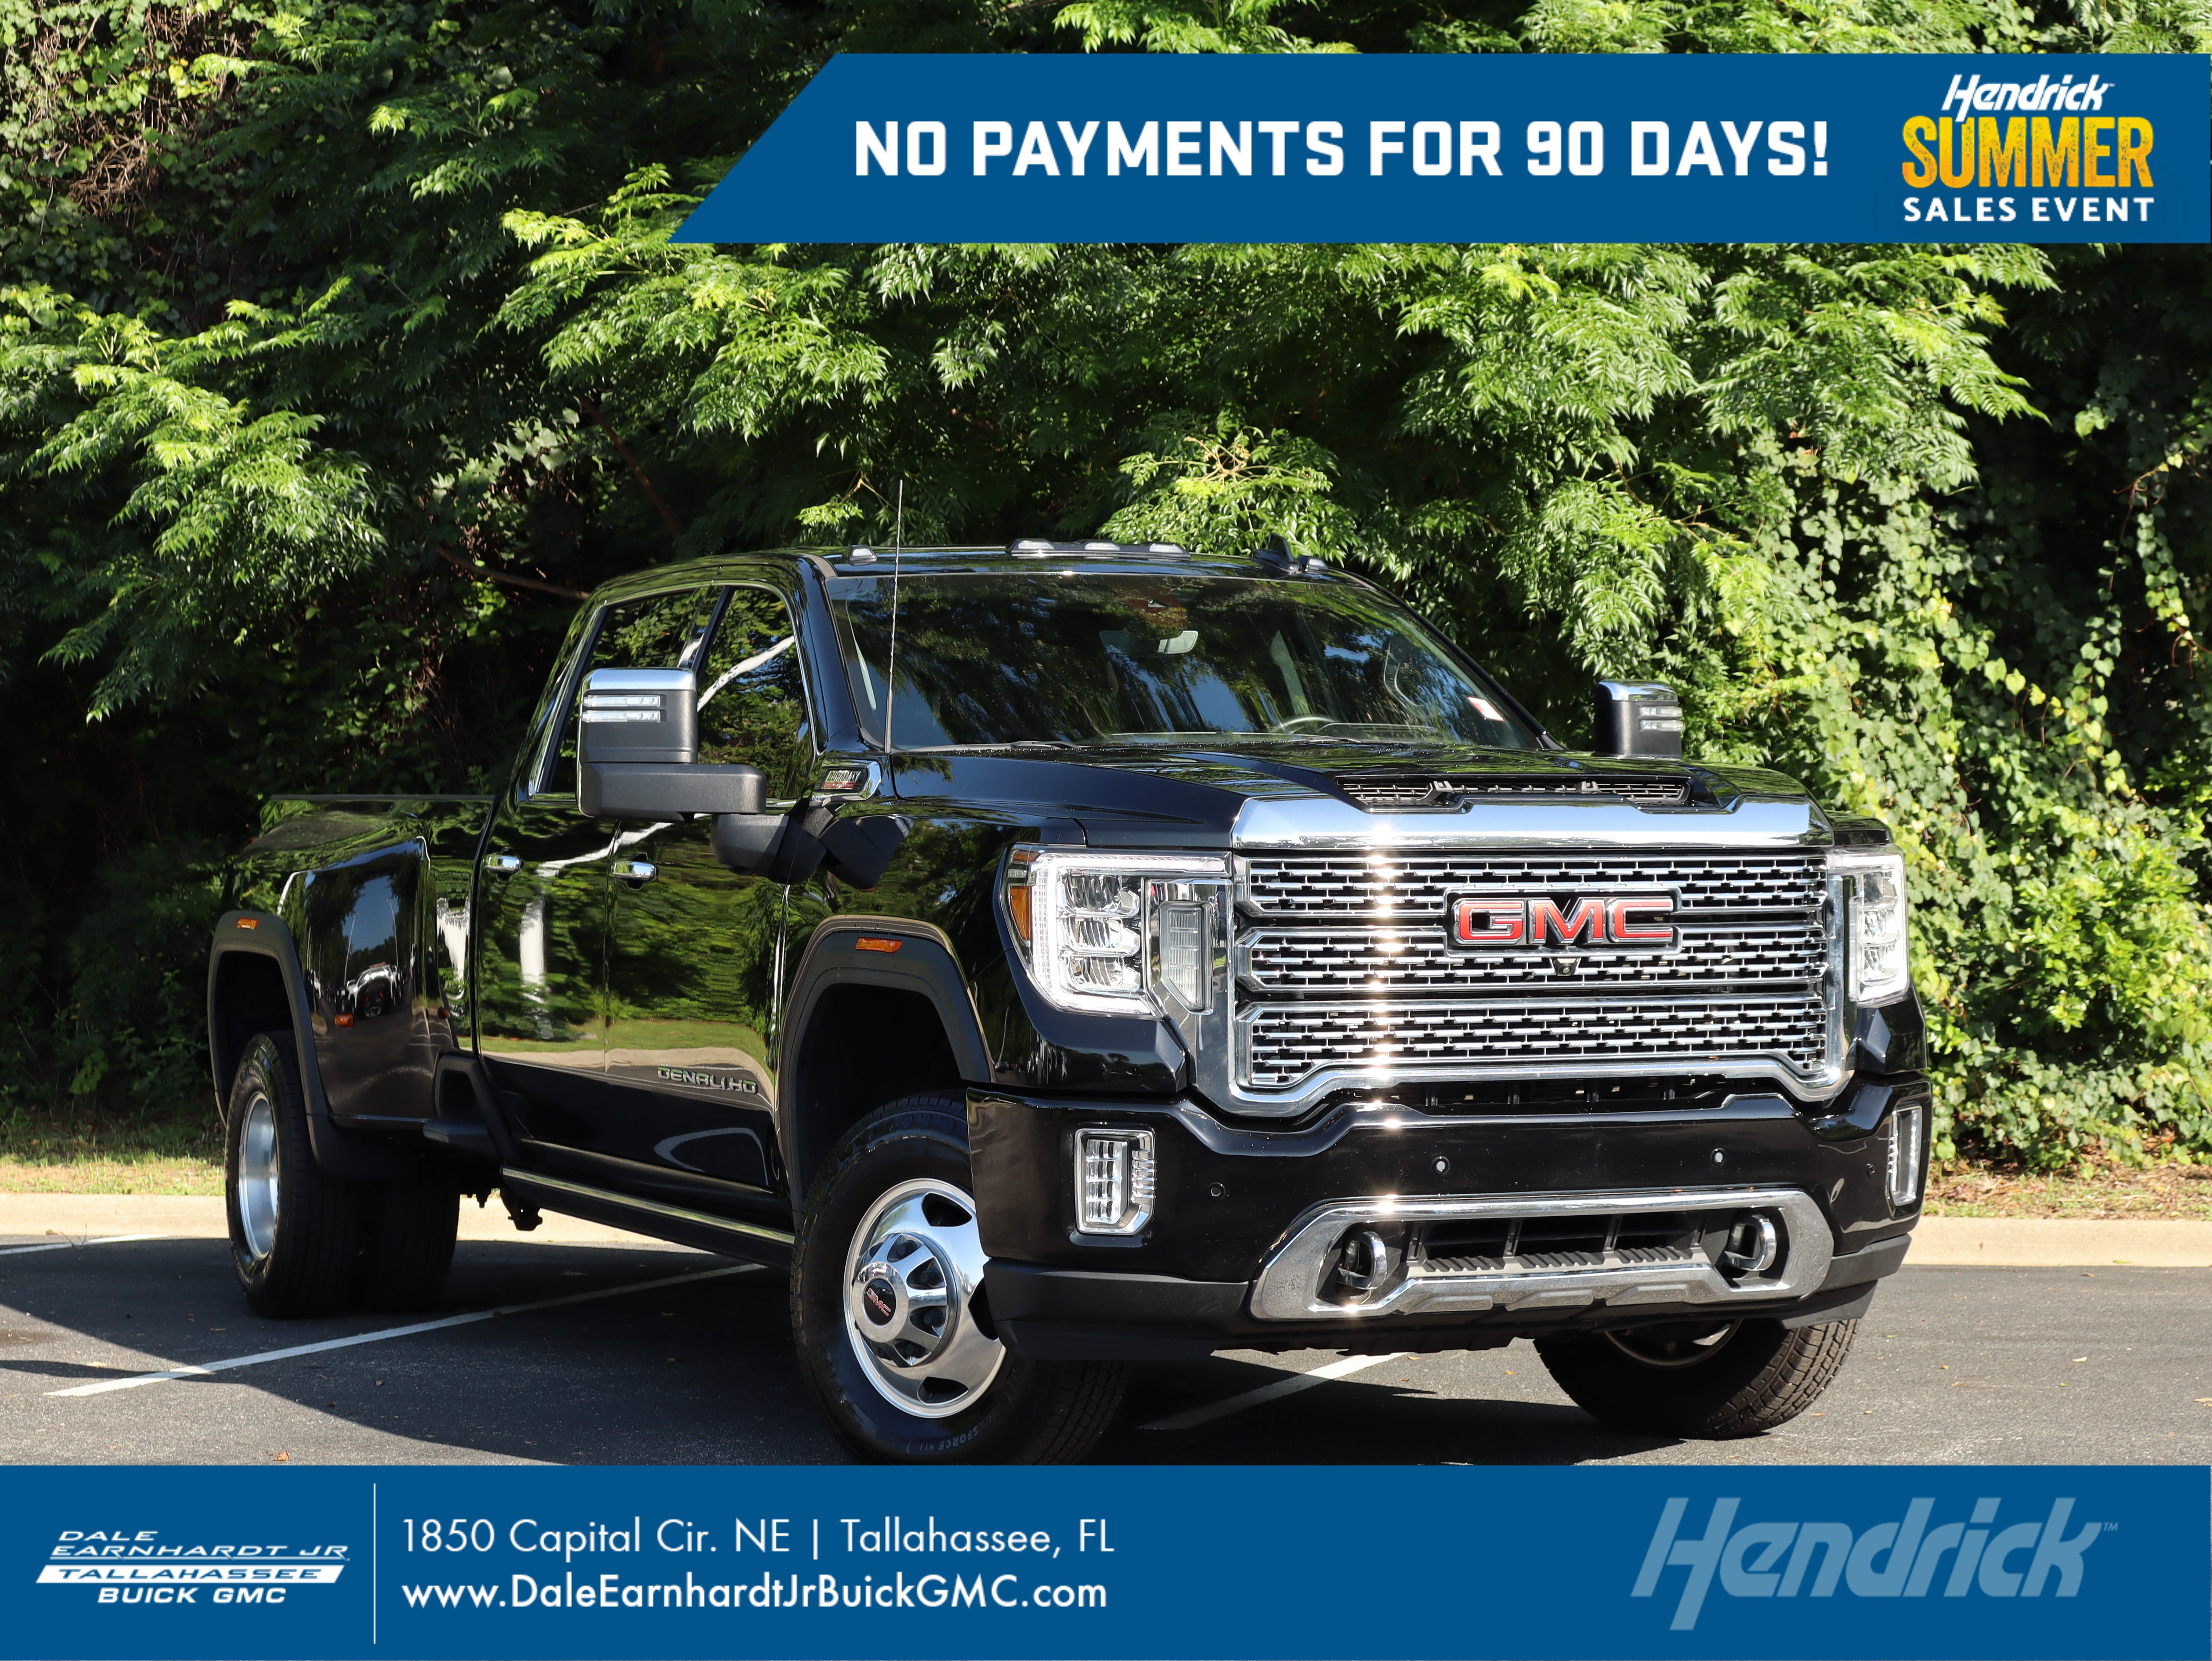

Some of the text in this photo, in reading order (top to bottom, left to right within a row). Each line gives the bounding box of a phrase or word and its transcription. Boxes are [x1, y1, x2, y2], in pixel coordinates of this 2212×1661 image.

[825, 770, 862, 783] DURAMAX
[1452, 897, 1674, 946] GMC
[657, 1066, 759, 1095] DENALI HD
[866, 1288, 891, 1317] GMC
